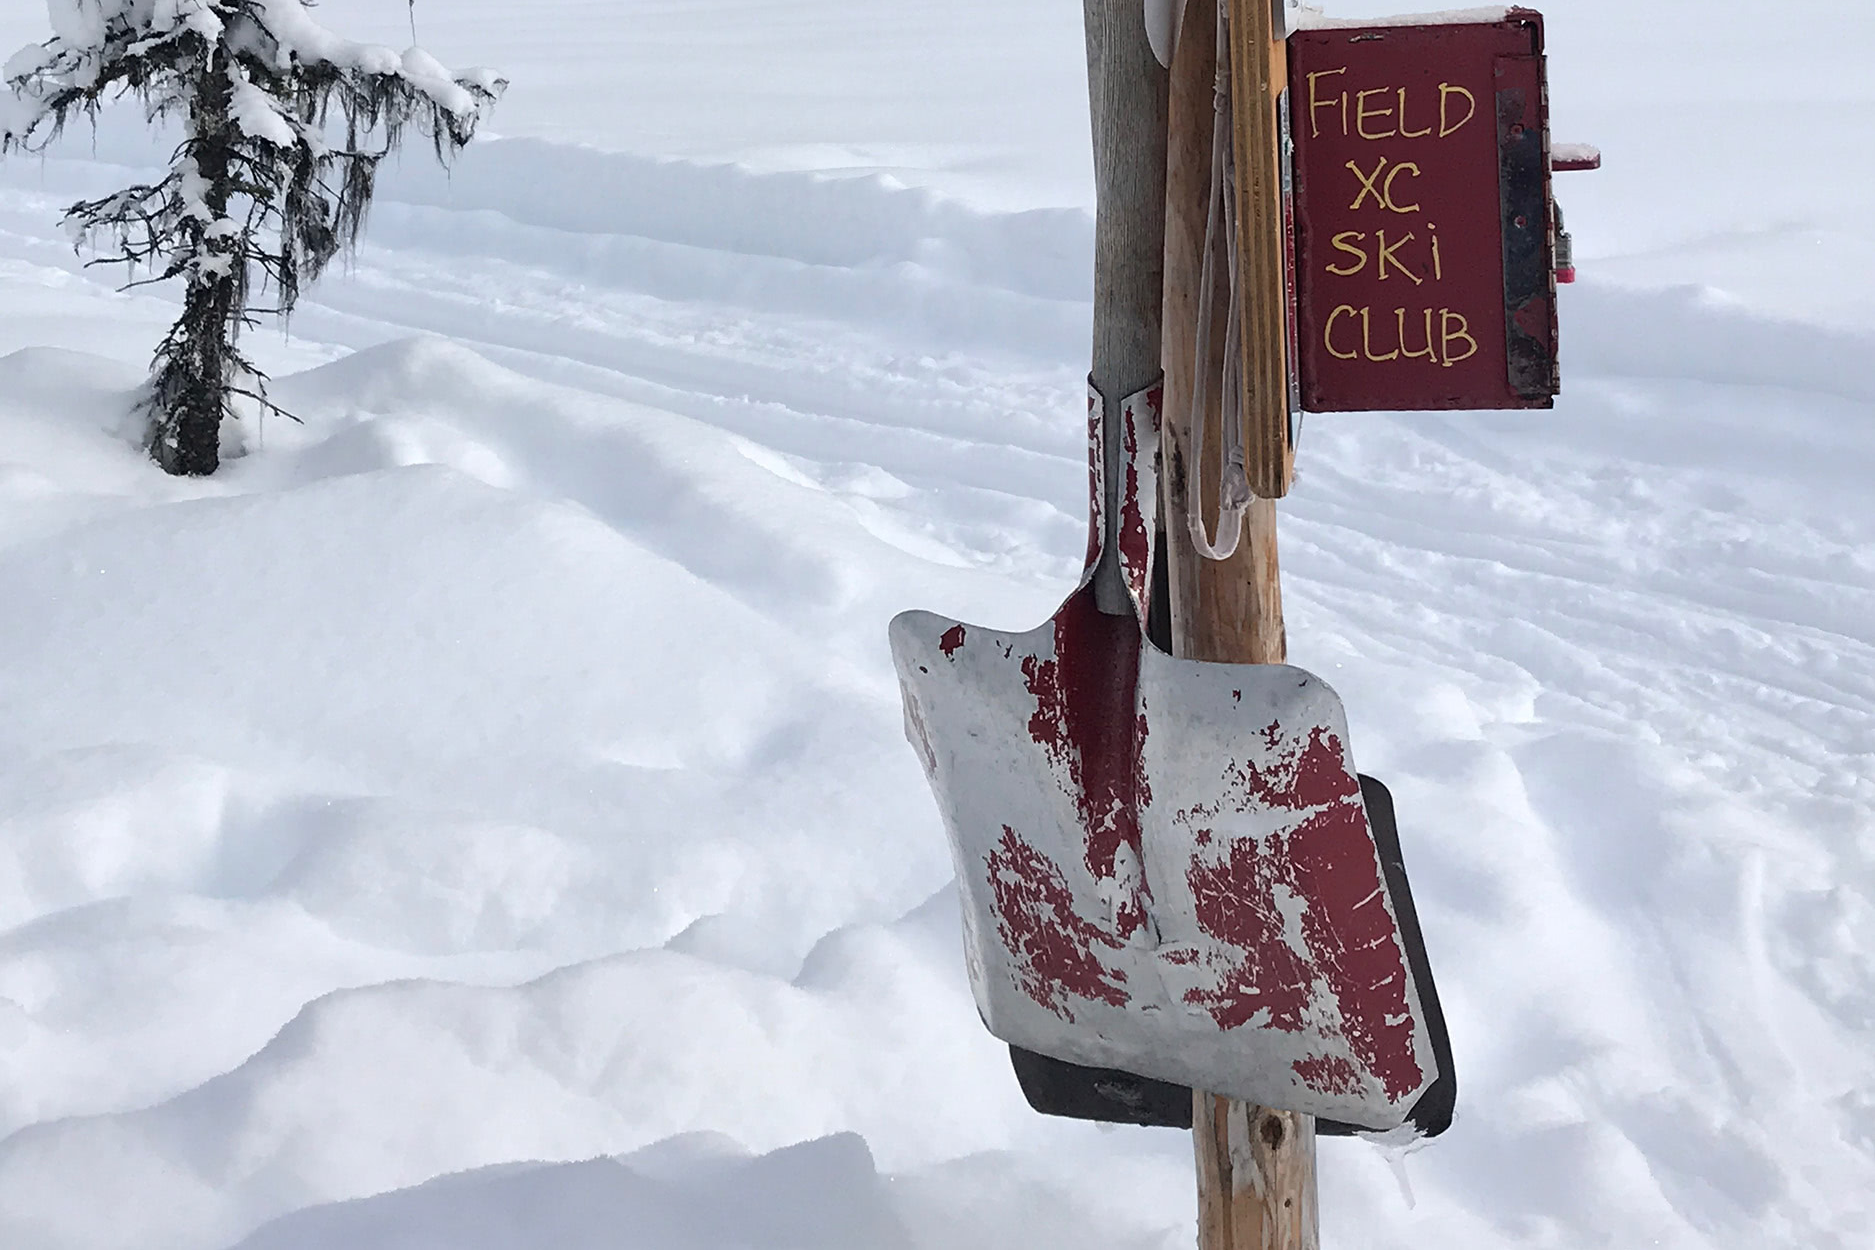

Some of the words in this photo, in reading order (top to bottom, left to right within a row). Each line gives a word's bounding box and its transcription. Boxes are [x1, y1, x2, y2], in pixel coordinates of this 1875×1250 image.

[1306, 66, 1476, 139] FIELD
[1345, 156, 1420, 213] XC
[1324, 305, 1478, 367] CLUB
